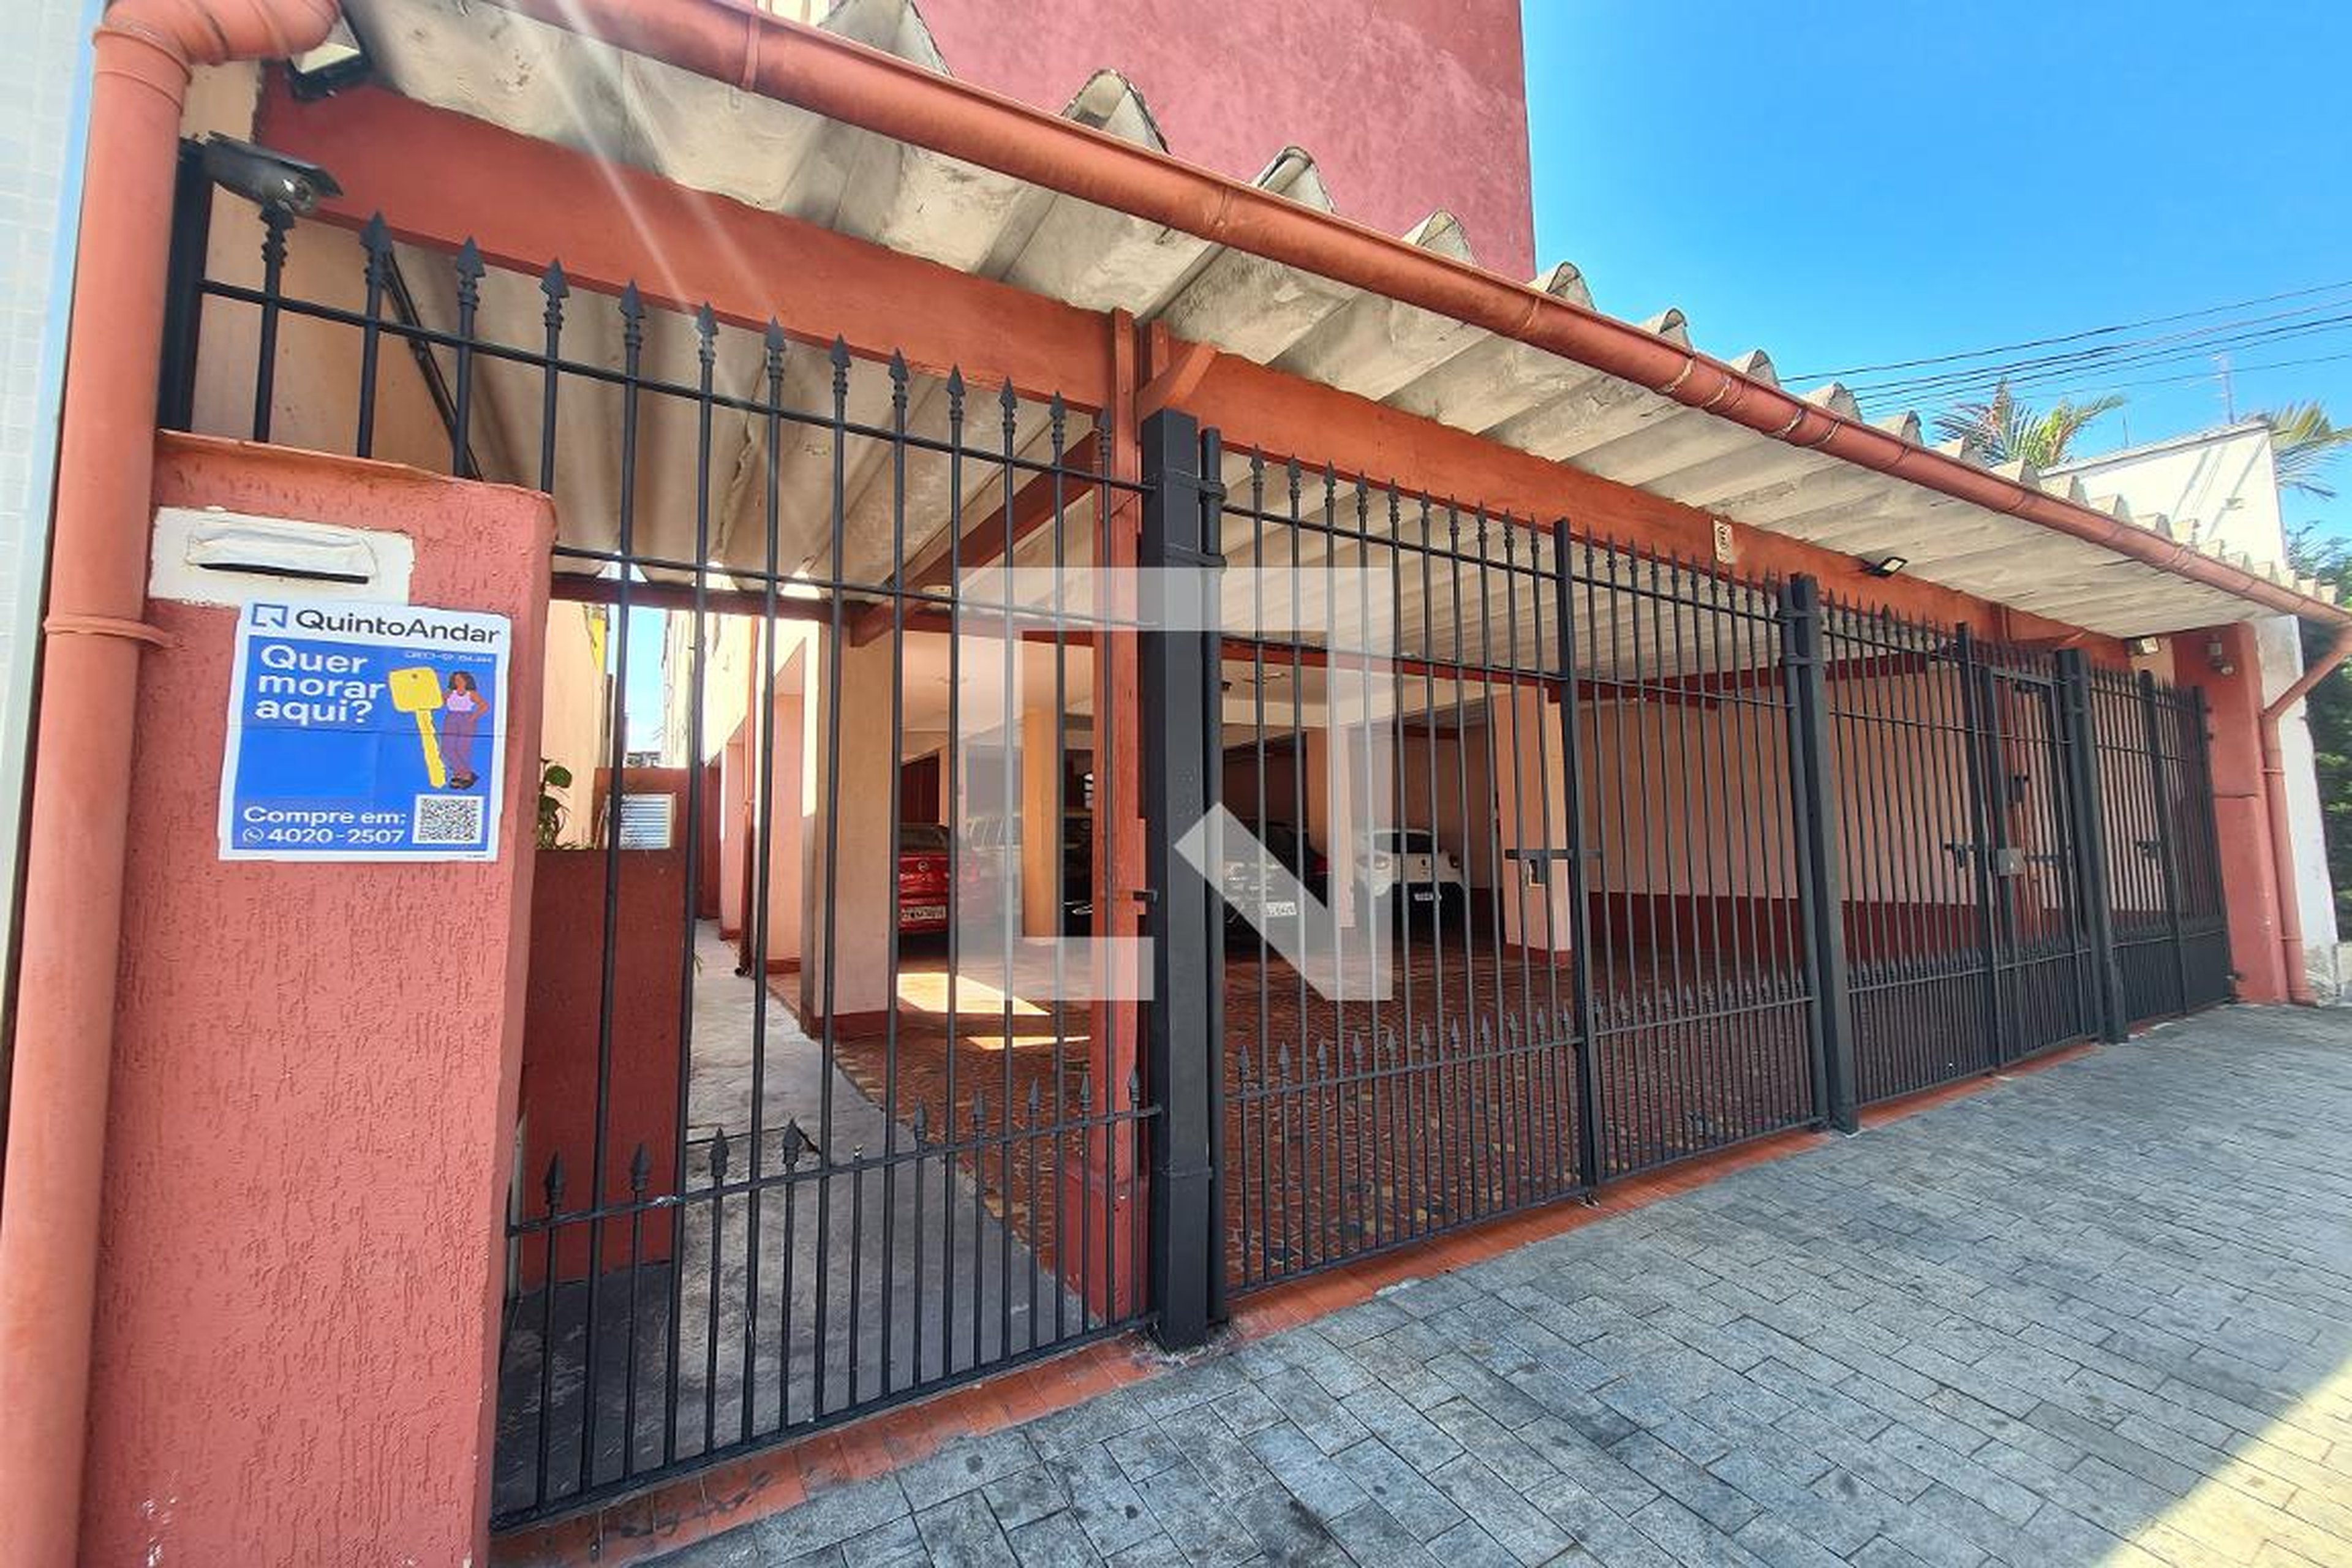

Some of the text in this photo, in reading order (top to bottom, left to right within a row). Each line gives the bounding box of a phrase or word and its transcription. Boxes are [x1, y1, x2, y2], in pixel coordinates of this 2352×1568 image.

[296, 609, 500, 644] QuintoAndar
[260, 644, 368, 673] Quer
[258, 674, 385, 699] morar
[255, 699, 372, 725] aqui?
[244, 806, 406, 827] Compre em:
